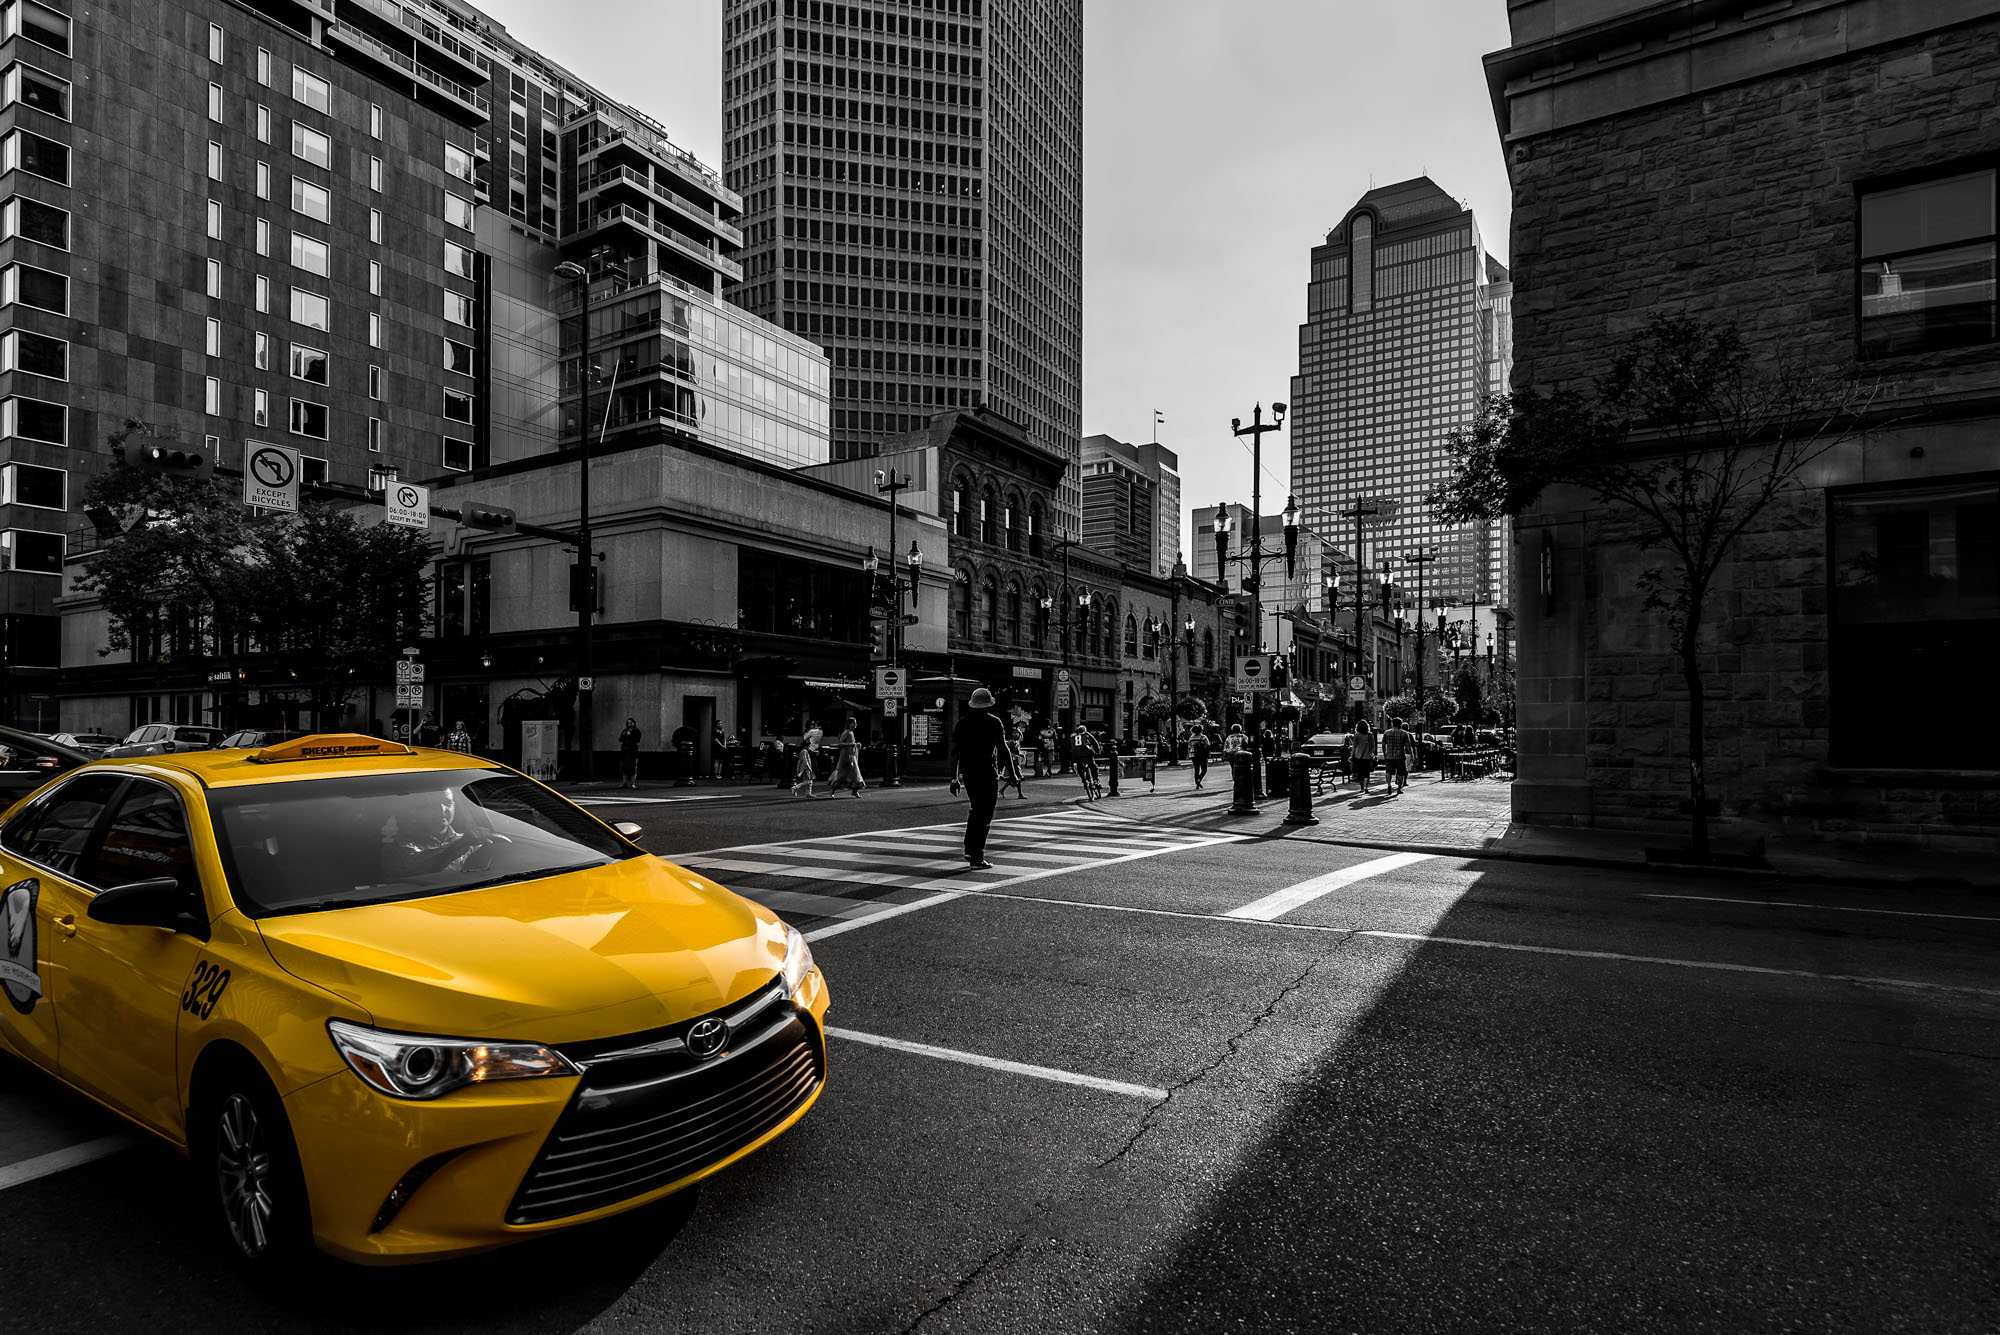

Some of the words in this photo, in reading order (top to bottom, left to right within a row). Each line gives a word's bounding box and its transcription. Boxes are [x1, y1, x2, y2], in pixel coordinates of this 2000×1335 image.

[256, 488, 287, 499] EXCEPT
[252, 495, 291, 507] BICYCLES
[389, 506, 427, 519] 06:00-18:00
[1058, 698, 1069, 707] 30
[1075, 735, 1082, 746] 8
[302, 745, 345, 755] CHECKER
[182, 960, 231, 1021] 329
